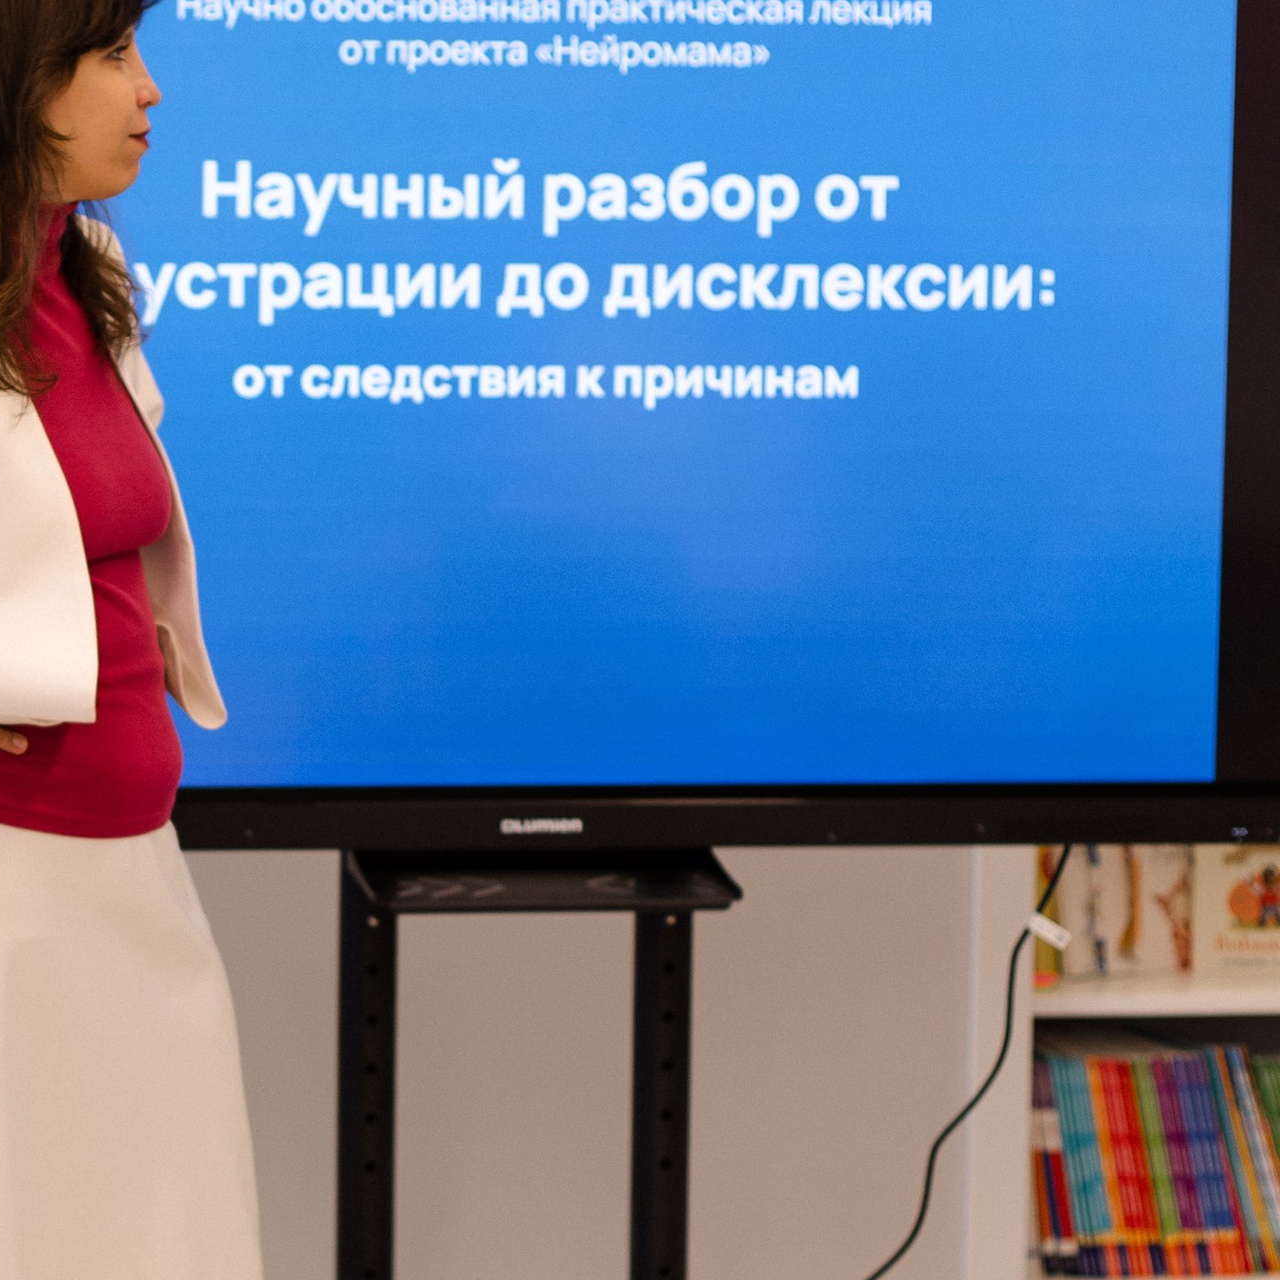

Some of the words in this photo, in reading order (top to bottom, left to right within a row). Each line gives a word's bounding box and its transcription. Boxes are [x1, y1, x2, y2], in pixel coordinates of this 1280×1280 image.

[338, 39, 382, 66] от
[386, 39, 528, 74] проекта
[535, 34, 770, 75] «Нейромама»
[202, 157, 525, 237] Научный
[543, 160, 801, 238] разбор
[814, 173, 901, 222] от
[496, 262, 590, 319] до
[603, 262, 1056, 319] дисклексии:
[233, 364, 293, 399] от
[300, 364, 566, 405] следствия
[576, 364, 606, 399] к
[613, 364, 860, 411] причинам
